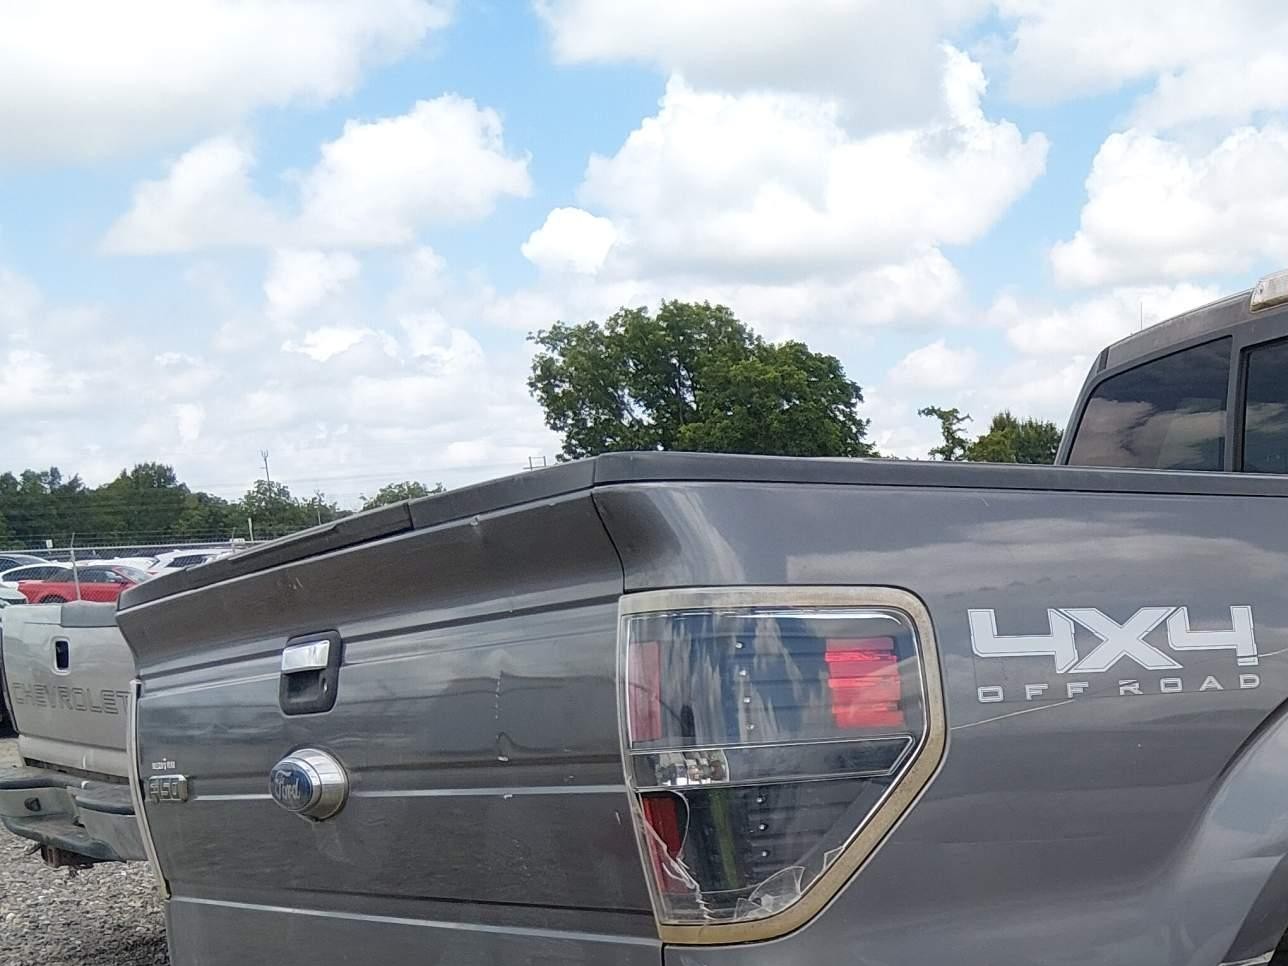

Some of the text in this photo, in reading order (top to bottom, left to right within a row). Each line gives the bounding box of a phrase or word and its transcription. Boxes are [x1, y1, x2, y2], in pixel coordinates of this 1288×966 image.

[12, 682, 132, 715] CHEVROLET
[976, 673, 1260, 703] OFF ROAD
